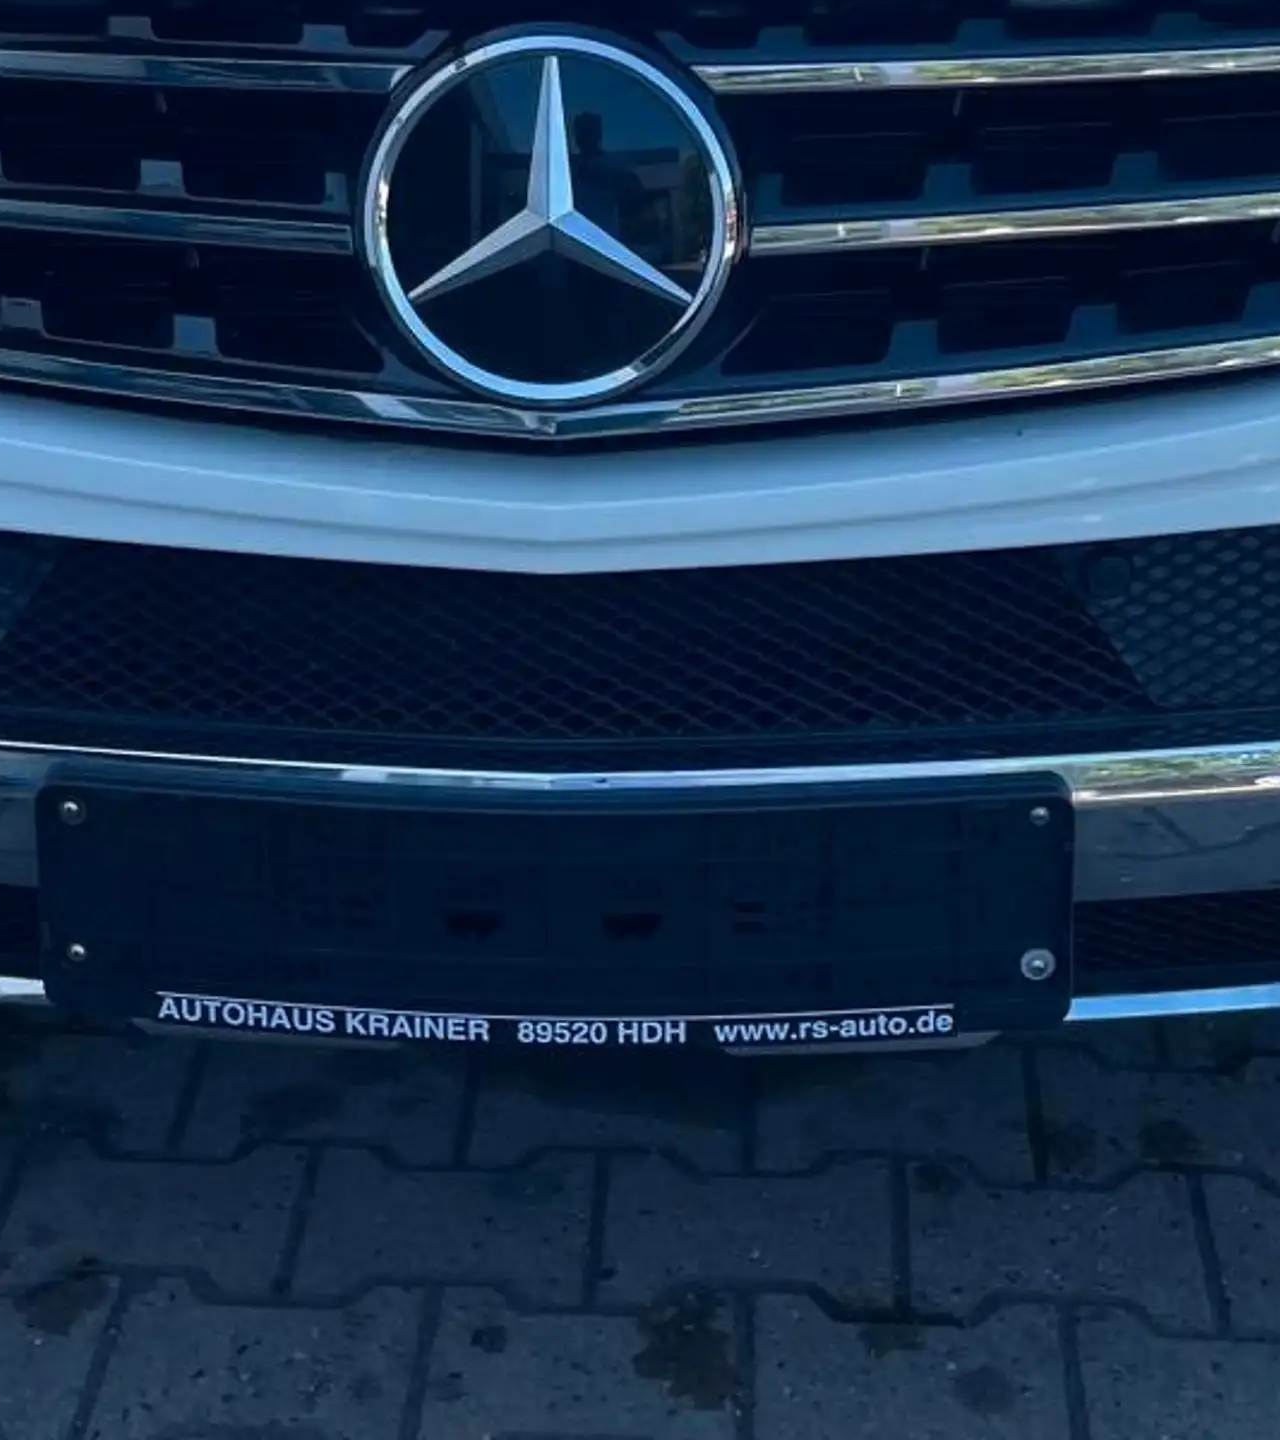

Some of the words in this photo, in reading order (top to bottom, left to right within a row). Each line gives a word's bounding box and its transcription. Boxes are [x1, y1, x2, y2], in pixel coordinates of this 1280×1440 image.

[158, 997, 336, 1034] AUTOHAUS
[345, 1012, 491, 1043] KRAINER
[517, 1020, 608, 1044] 89520
[618, 1020, 687, 1044] HDH
[713, 1010, 954, 1043] www.rs-auto.de
